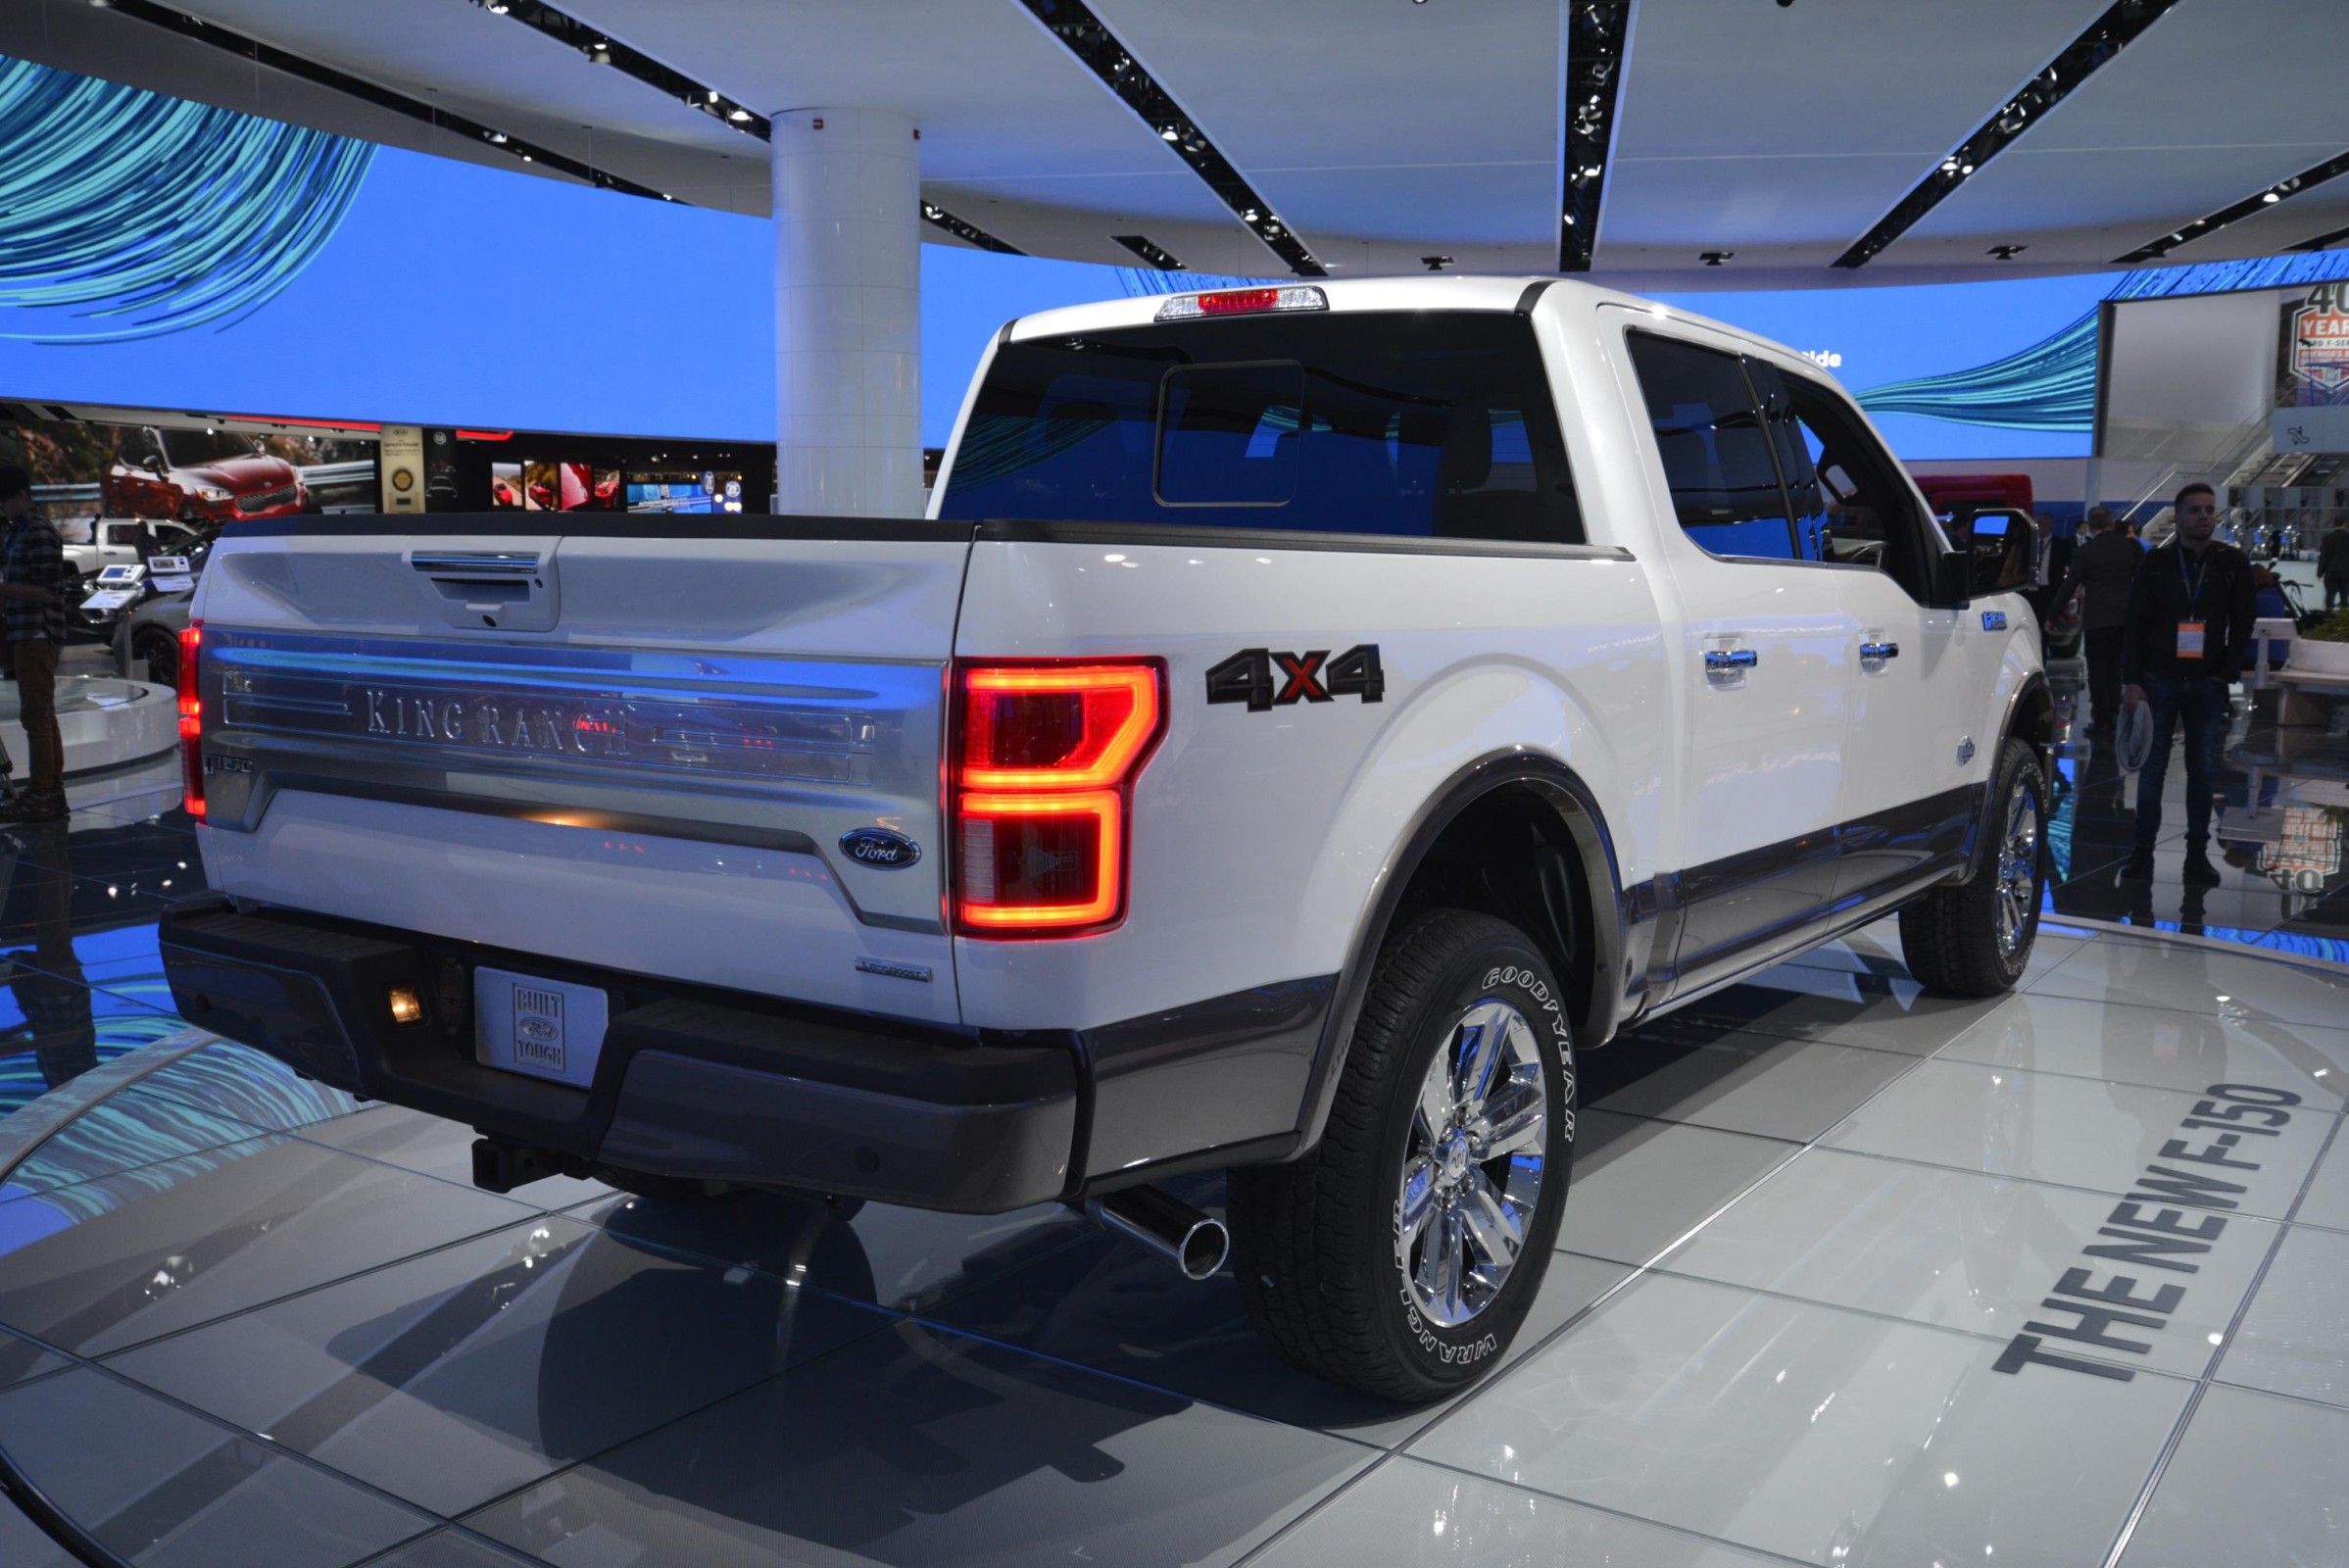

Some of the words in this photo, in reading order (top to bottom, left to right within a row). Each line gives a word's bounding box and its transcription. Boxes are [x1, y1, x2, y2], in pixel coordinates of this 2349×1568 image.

[367, 689, 463, 739] KING
[482, 705, 631, 756] RANCH
[855, 836, 900, 862] Ford
[517, 989, 562, 1018] BUILT
[517, 1040, 562, 1065] TOUGH
[1482, 965, 1575, 1143] GOODYEAR
[2158, 1083, 2302, 1170] F-150
[2081, 1164, 2248, 1273] NEW
[1393, 1198, 1497, 1364] WRANGLER
[1991, 1266, 2186, 1382] THE
